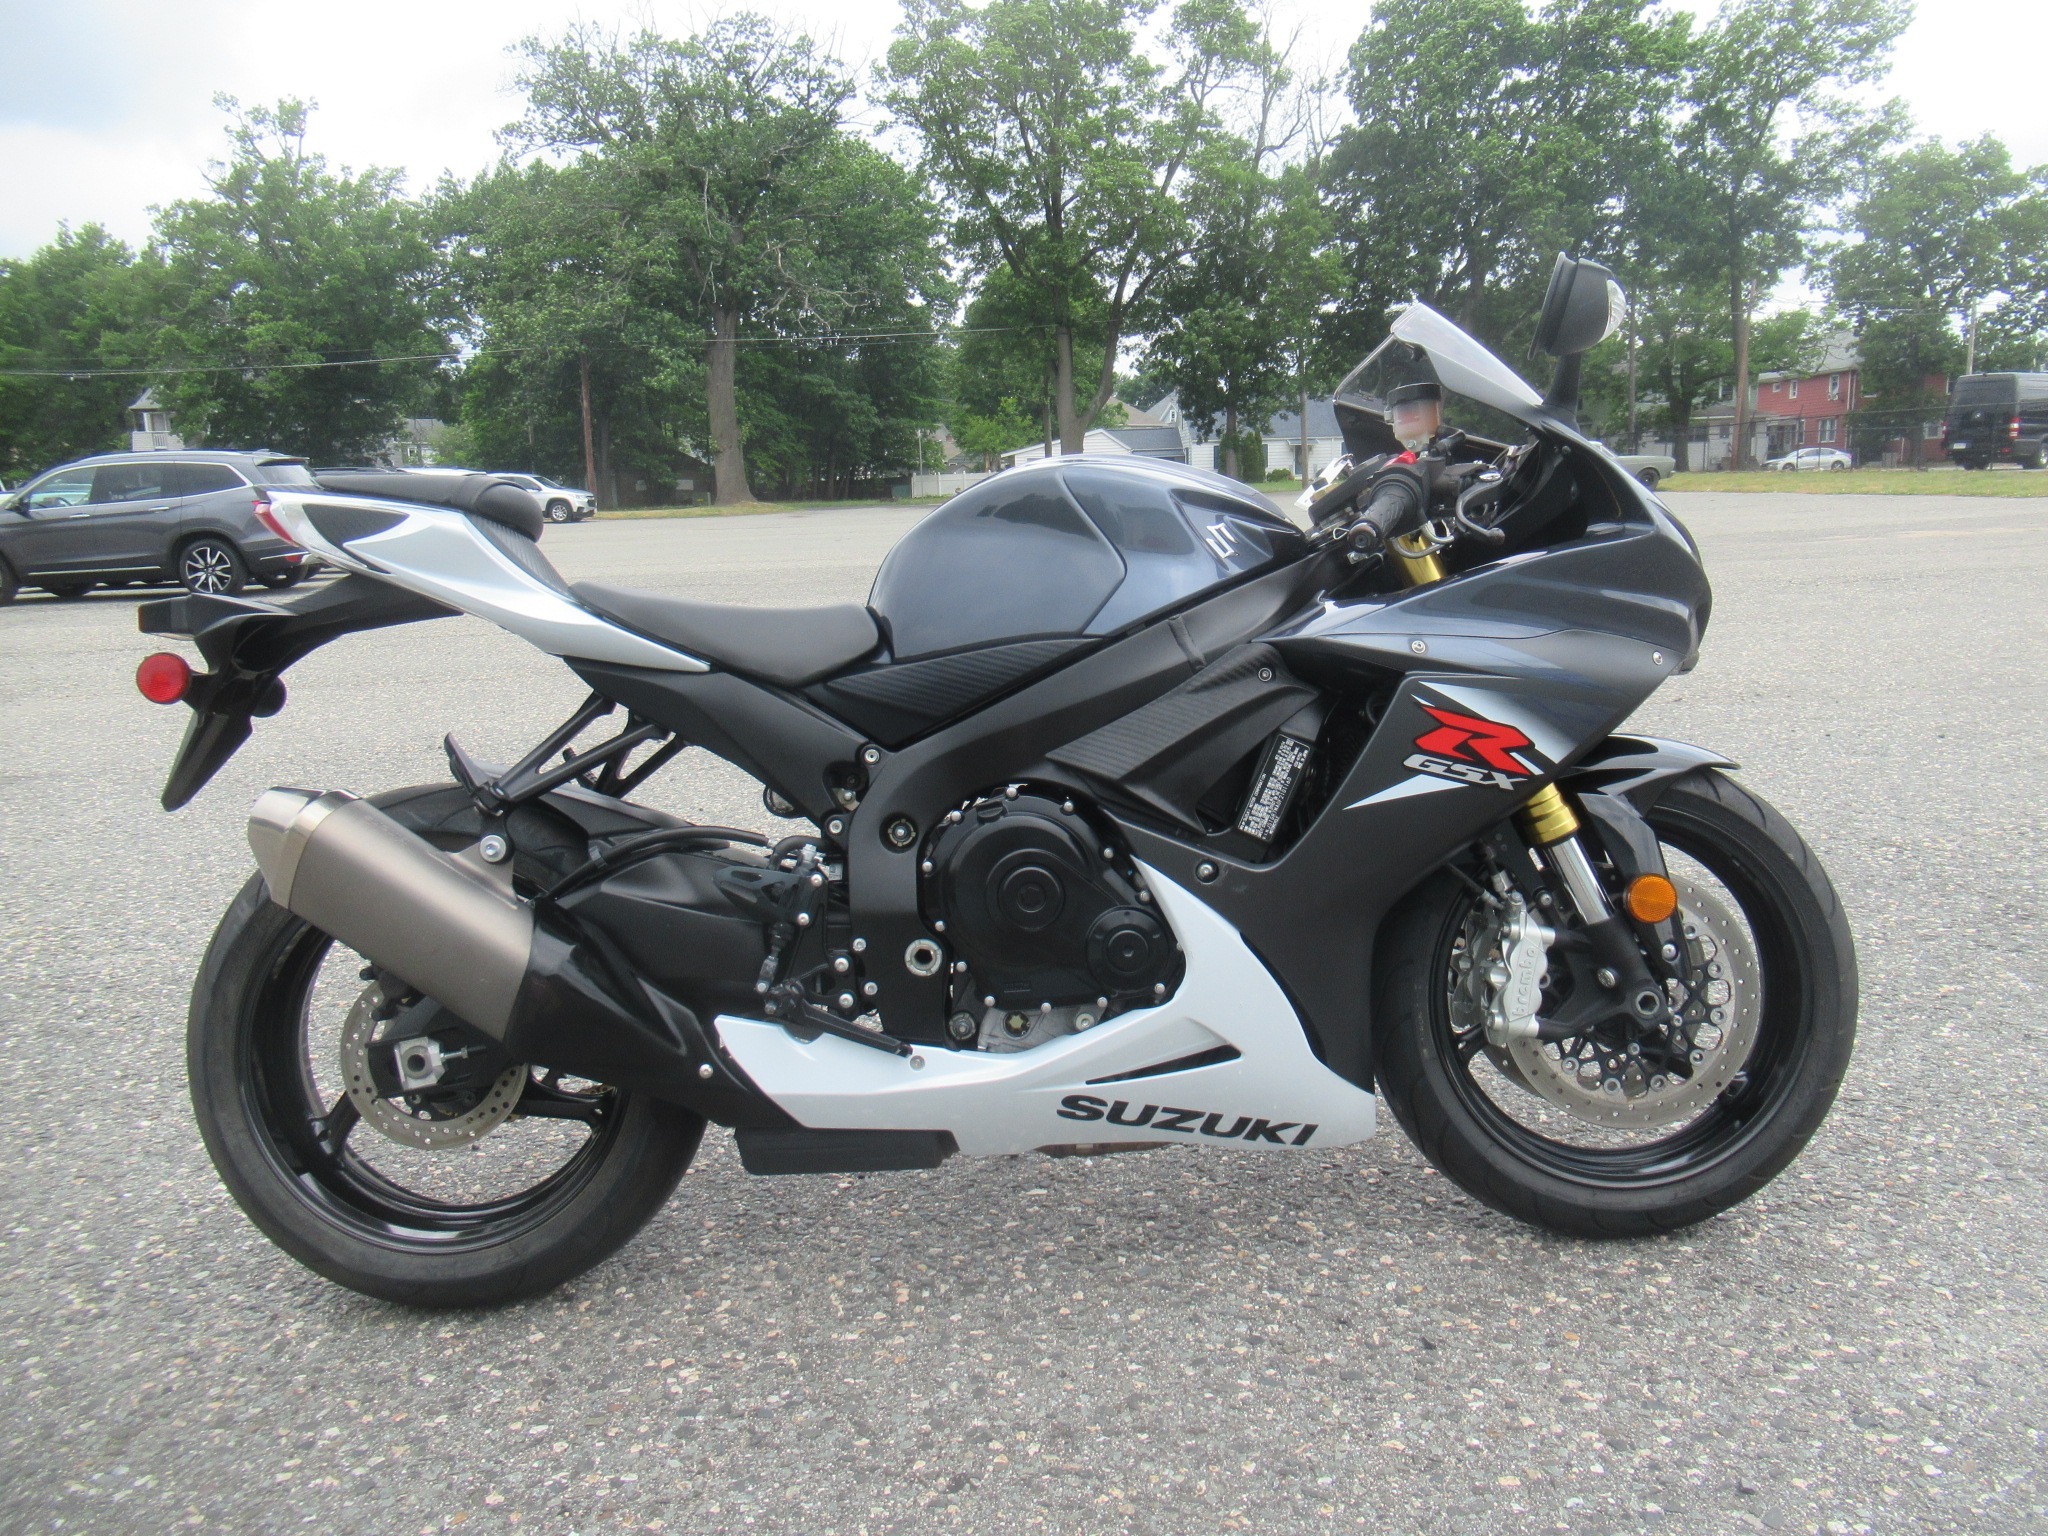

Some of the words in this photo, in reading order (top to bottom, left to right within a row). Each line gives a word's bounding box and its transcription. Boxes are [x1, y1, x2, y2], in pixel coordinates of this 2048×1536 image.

[1403, 753, 1528, 791] GSX
[1512, 948, 1535, 1017] brembo
[1056, 1094, 1319, 1146] SUZUKI
